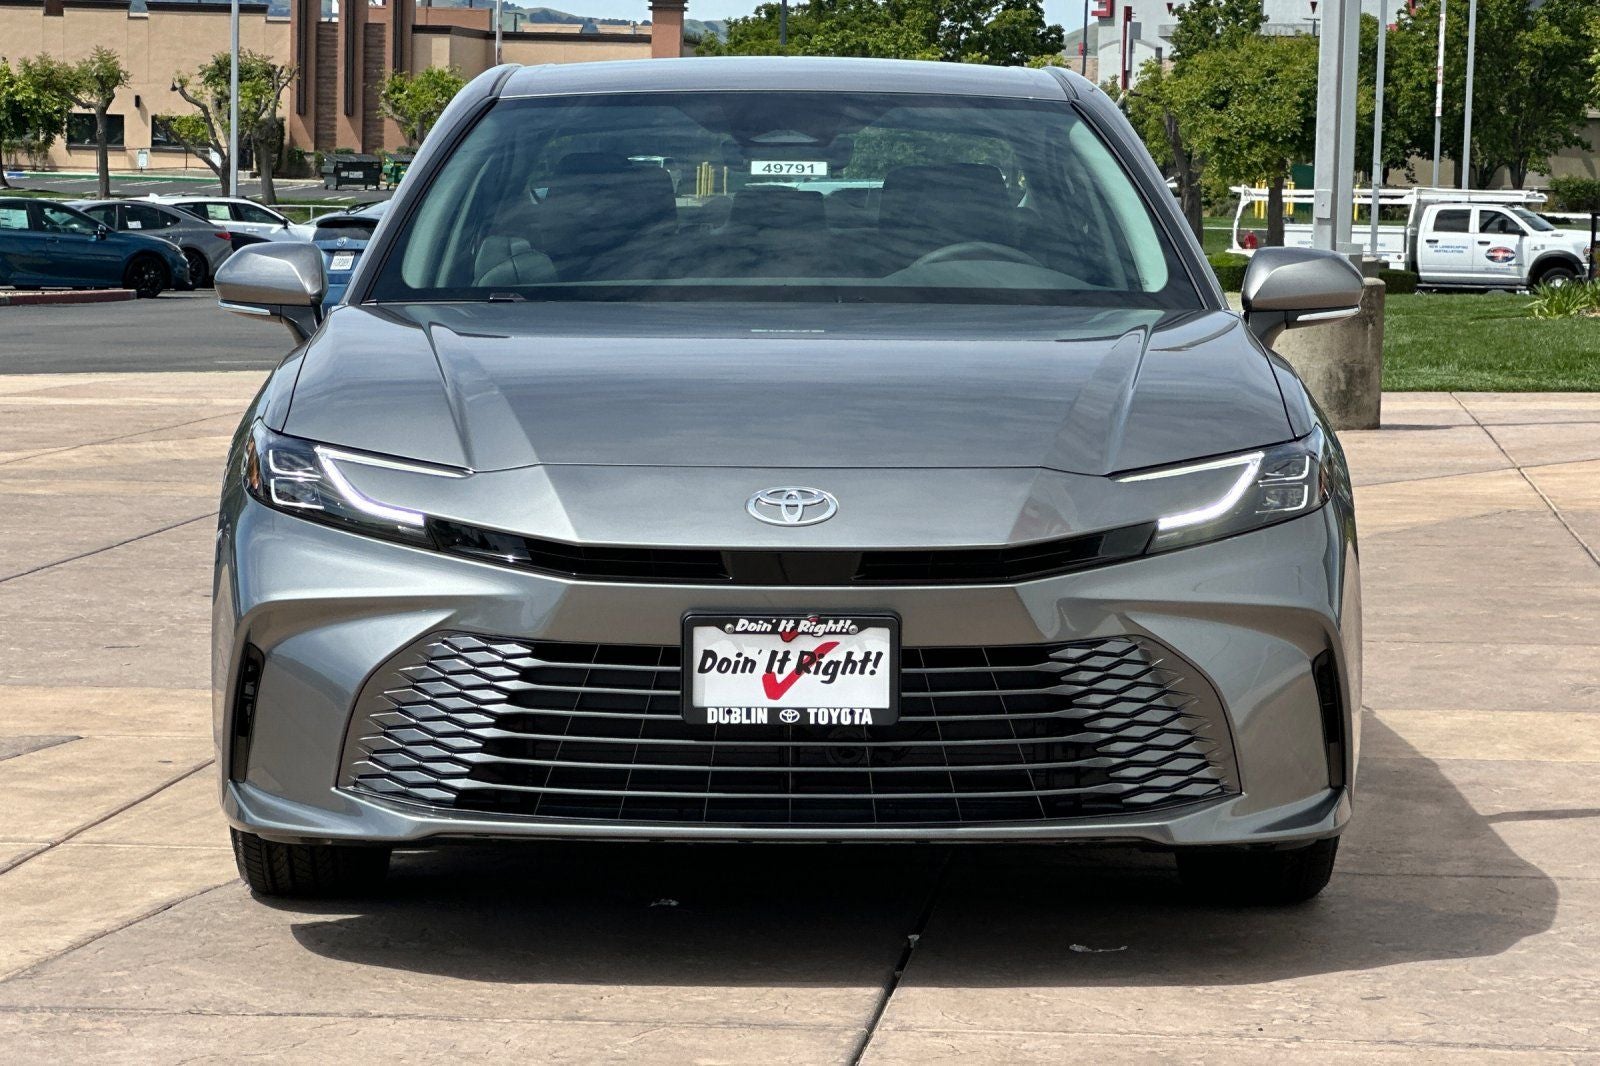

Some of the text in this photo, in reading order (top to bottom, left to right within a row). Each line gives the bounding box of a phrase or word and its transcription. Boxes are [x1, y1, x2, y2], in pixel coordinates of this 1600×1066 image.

[762, 163, 815, 174] 49791
[735, 618, 850, 637] Doin' It Right!
[697, 649, 884, 684] Doin' It Right!
[707, 708, 873, 725] DUBLIN TOYOTA
